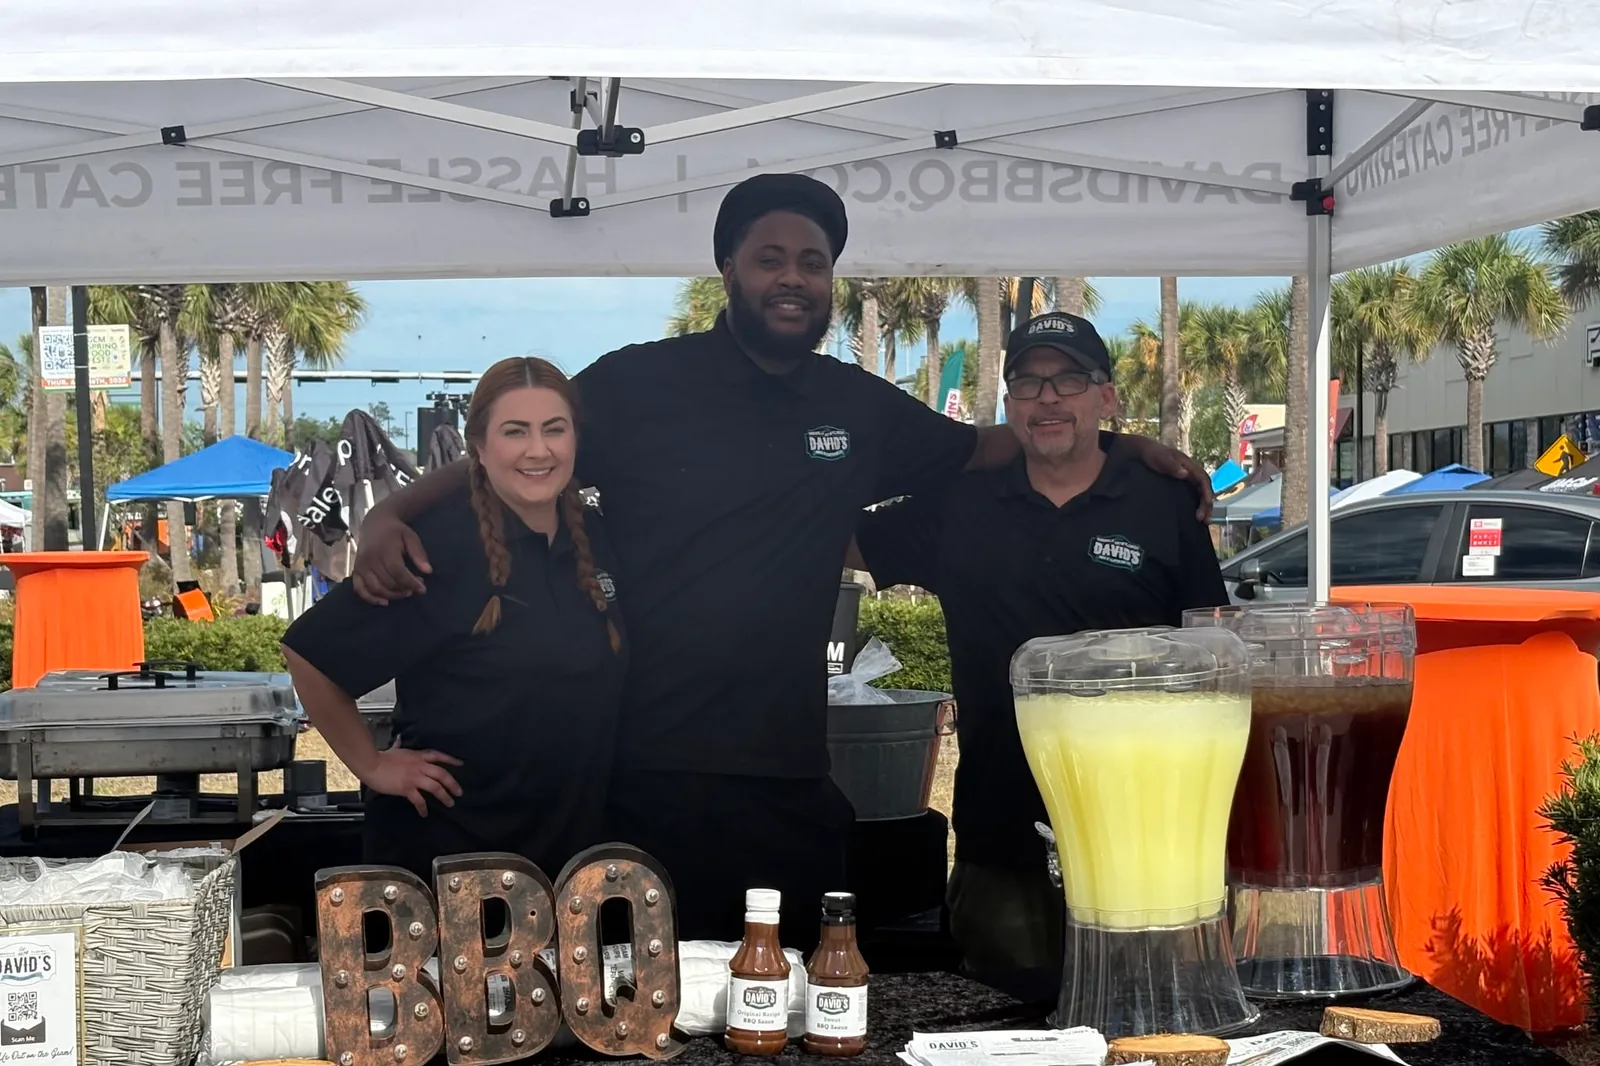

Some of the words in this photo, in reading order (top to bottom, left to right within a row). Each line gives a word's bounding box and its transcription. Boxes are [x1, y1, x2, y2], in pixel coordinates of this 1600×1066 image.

[1028, 319, 1075, 334] DAVID'S
[809, 435, 848, 451] DAVID'S
[1093, 541, 1141, 565] DAVID'S
[315, 842, 681, 1066] BBQ
[0, 955, 52, 974] AVID'S
[745, 992, 776, 1004] DAVID'S
[818, 997, 849, 1009] DAVID'S
[816, 1022, 830, 1030] BBQ
[929, 1040, 979, 1050] DAVID'S
